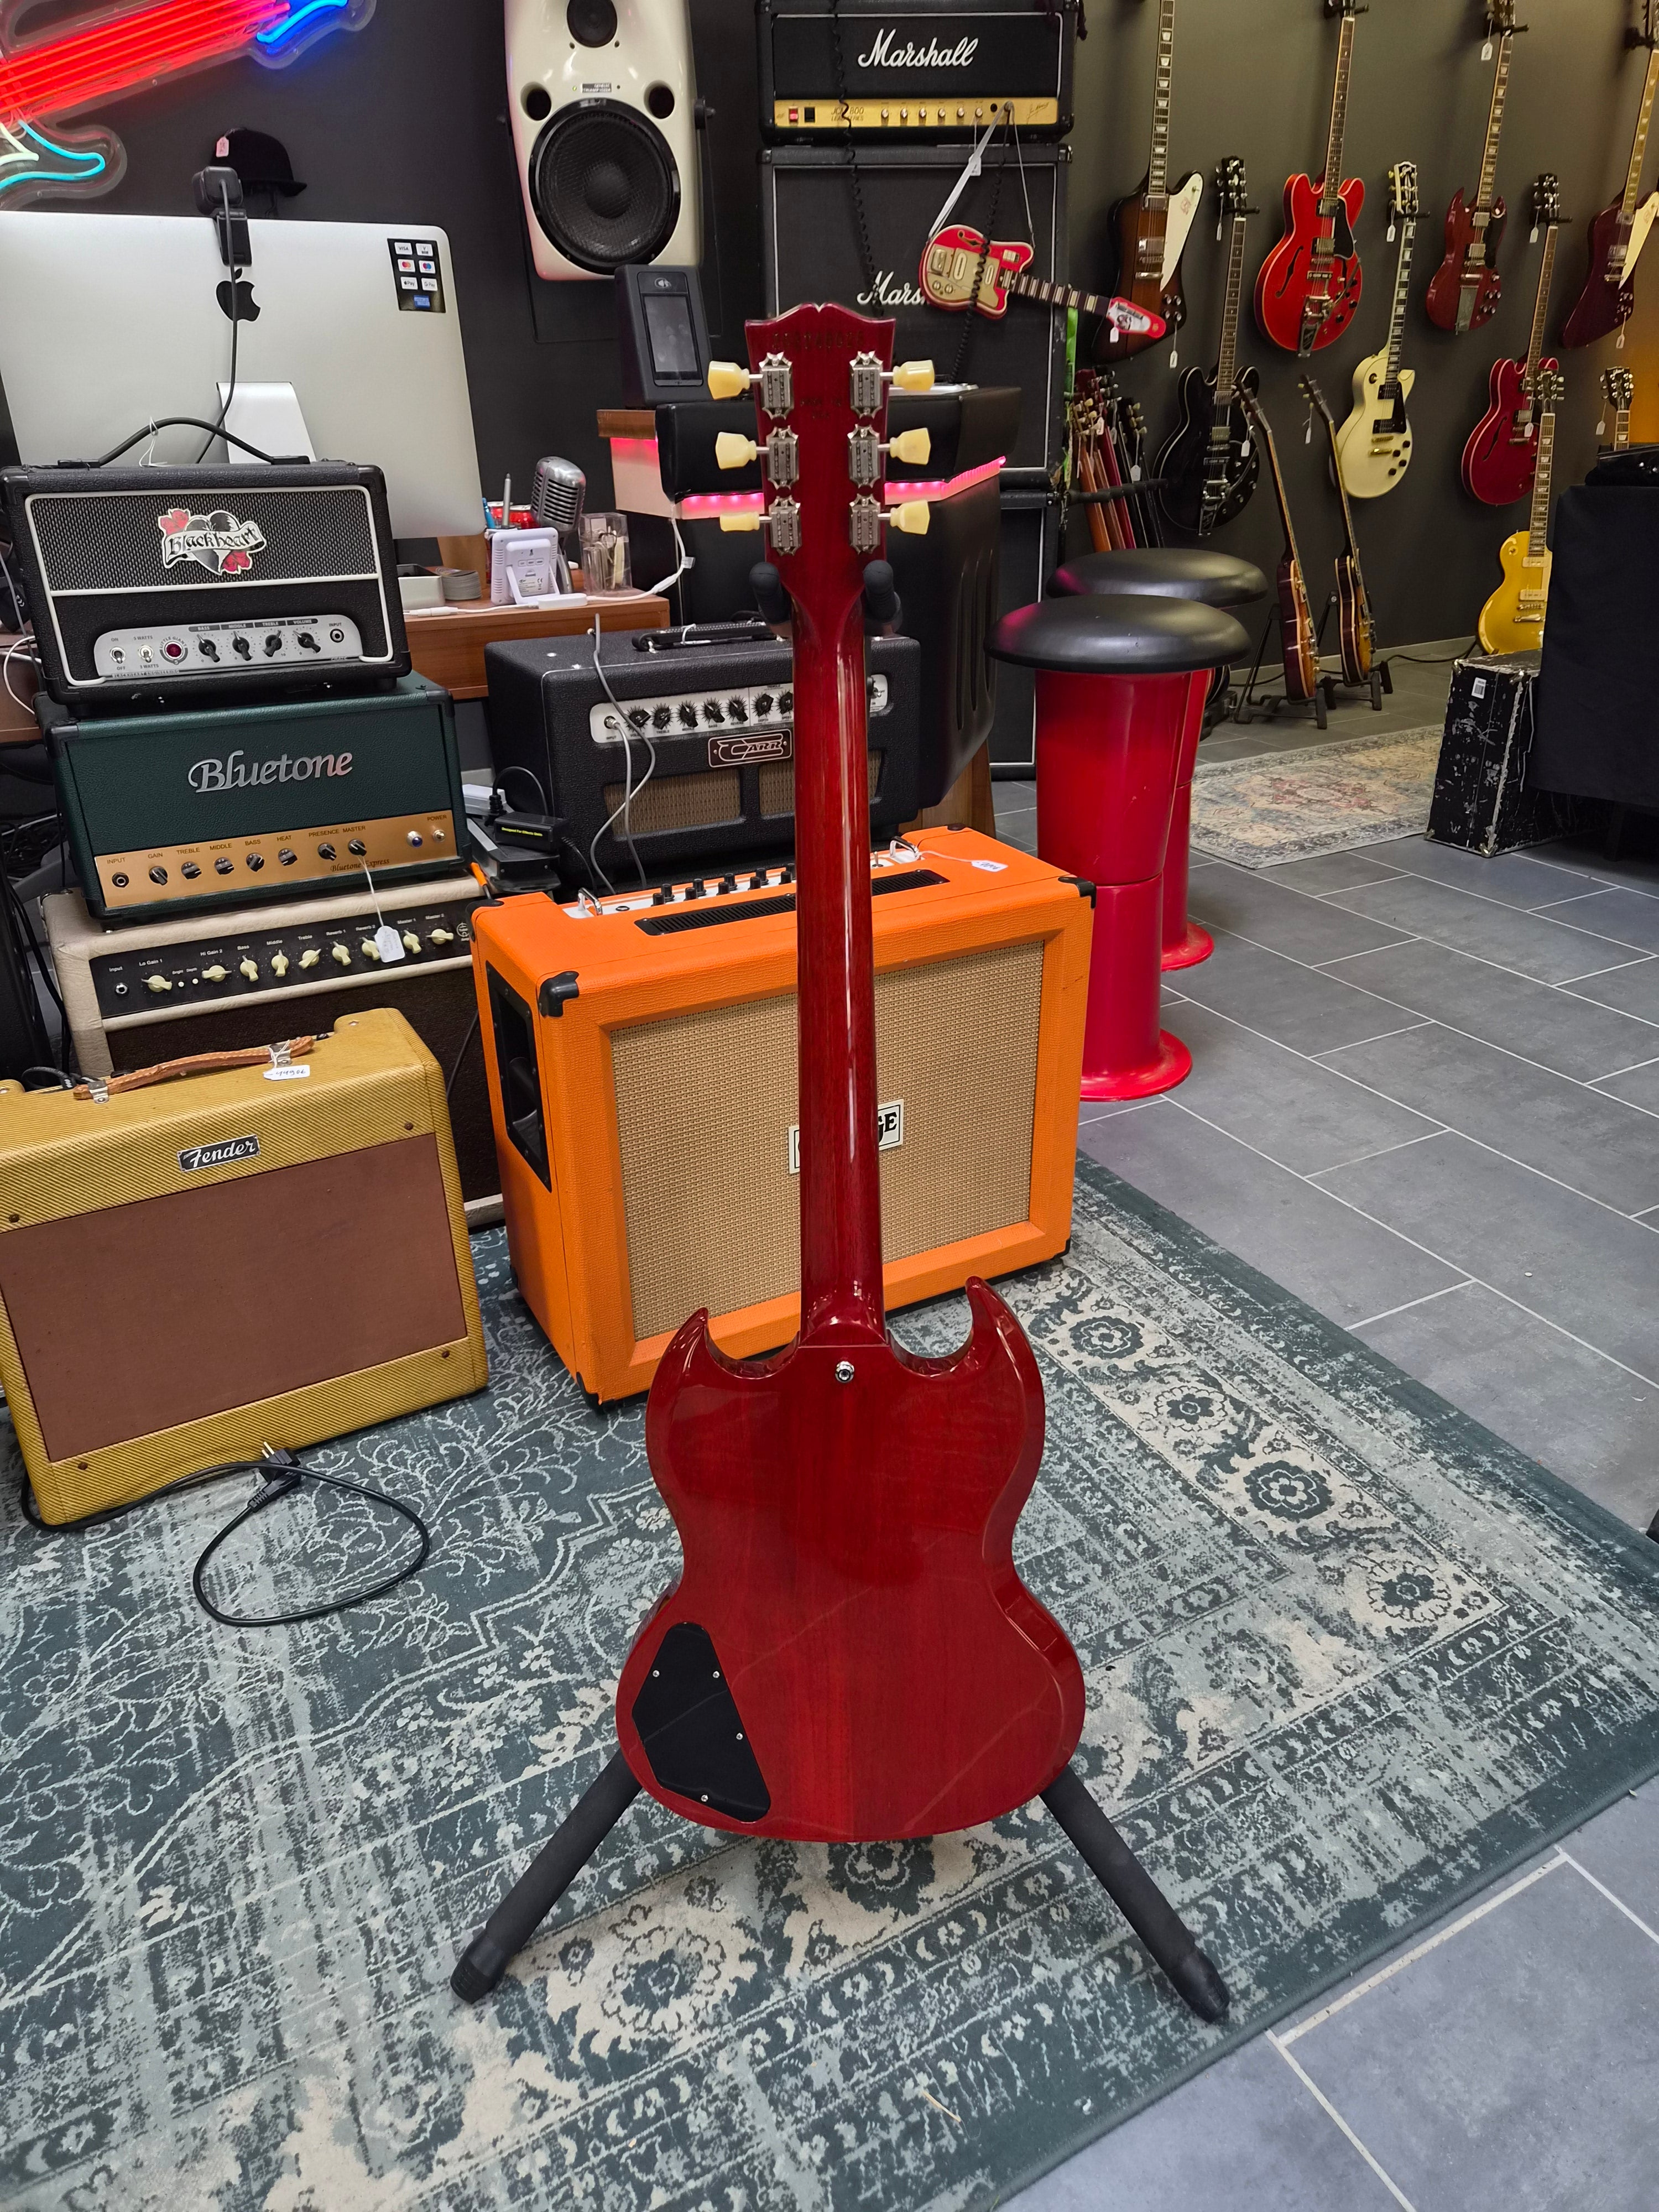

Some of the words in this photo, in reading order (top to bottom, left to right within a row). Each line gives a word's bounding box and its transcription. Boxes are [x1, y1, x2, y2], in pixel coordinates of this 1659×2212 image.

[858, 28, 979, 67] Marshall
[849, 107, 864, 115] 800
[857, 270, 925, 305] Mars
[168, 526, 259, 556] Blackheart
[717, 733, 784, 761] CARR
[188, 750, 353, 793] Bluetone
[309, 829, 340, 837] PRESENCE
[330, 862, 361, 872] Bluetone
[365, 858, 390, 870] Express
[183, 1140, 255, 1168] Fender
